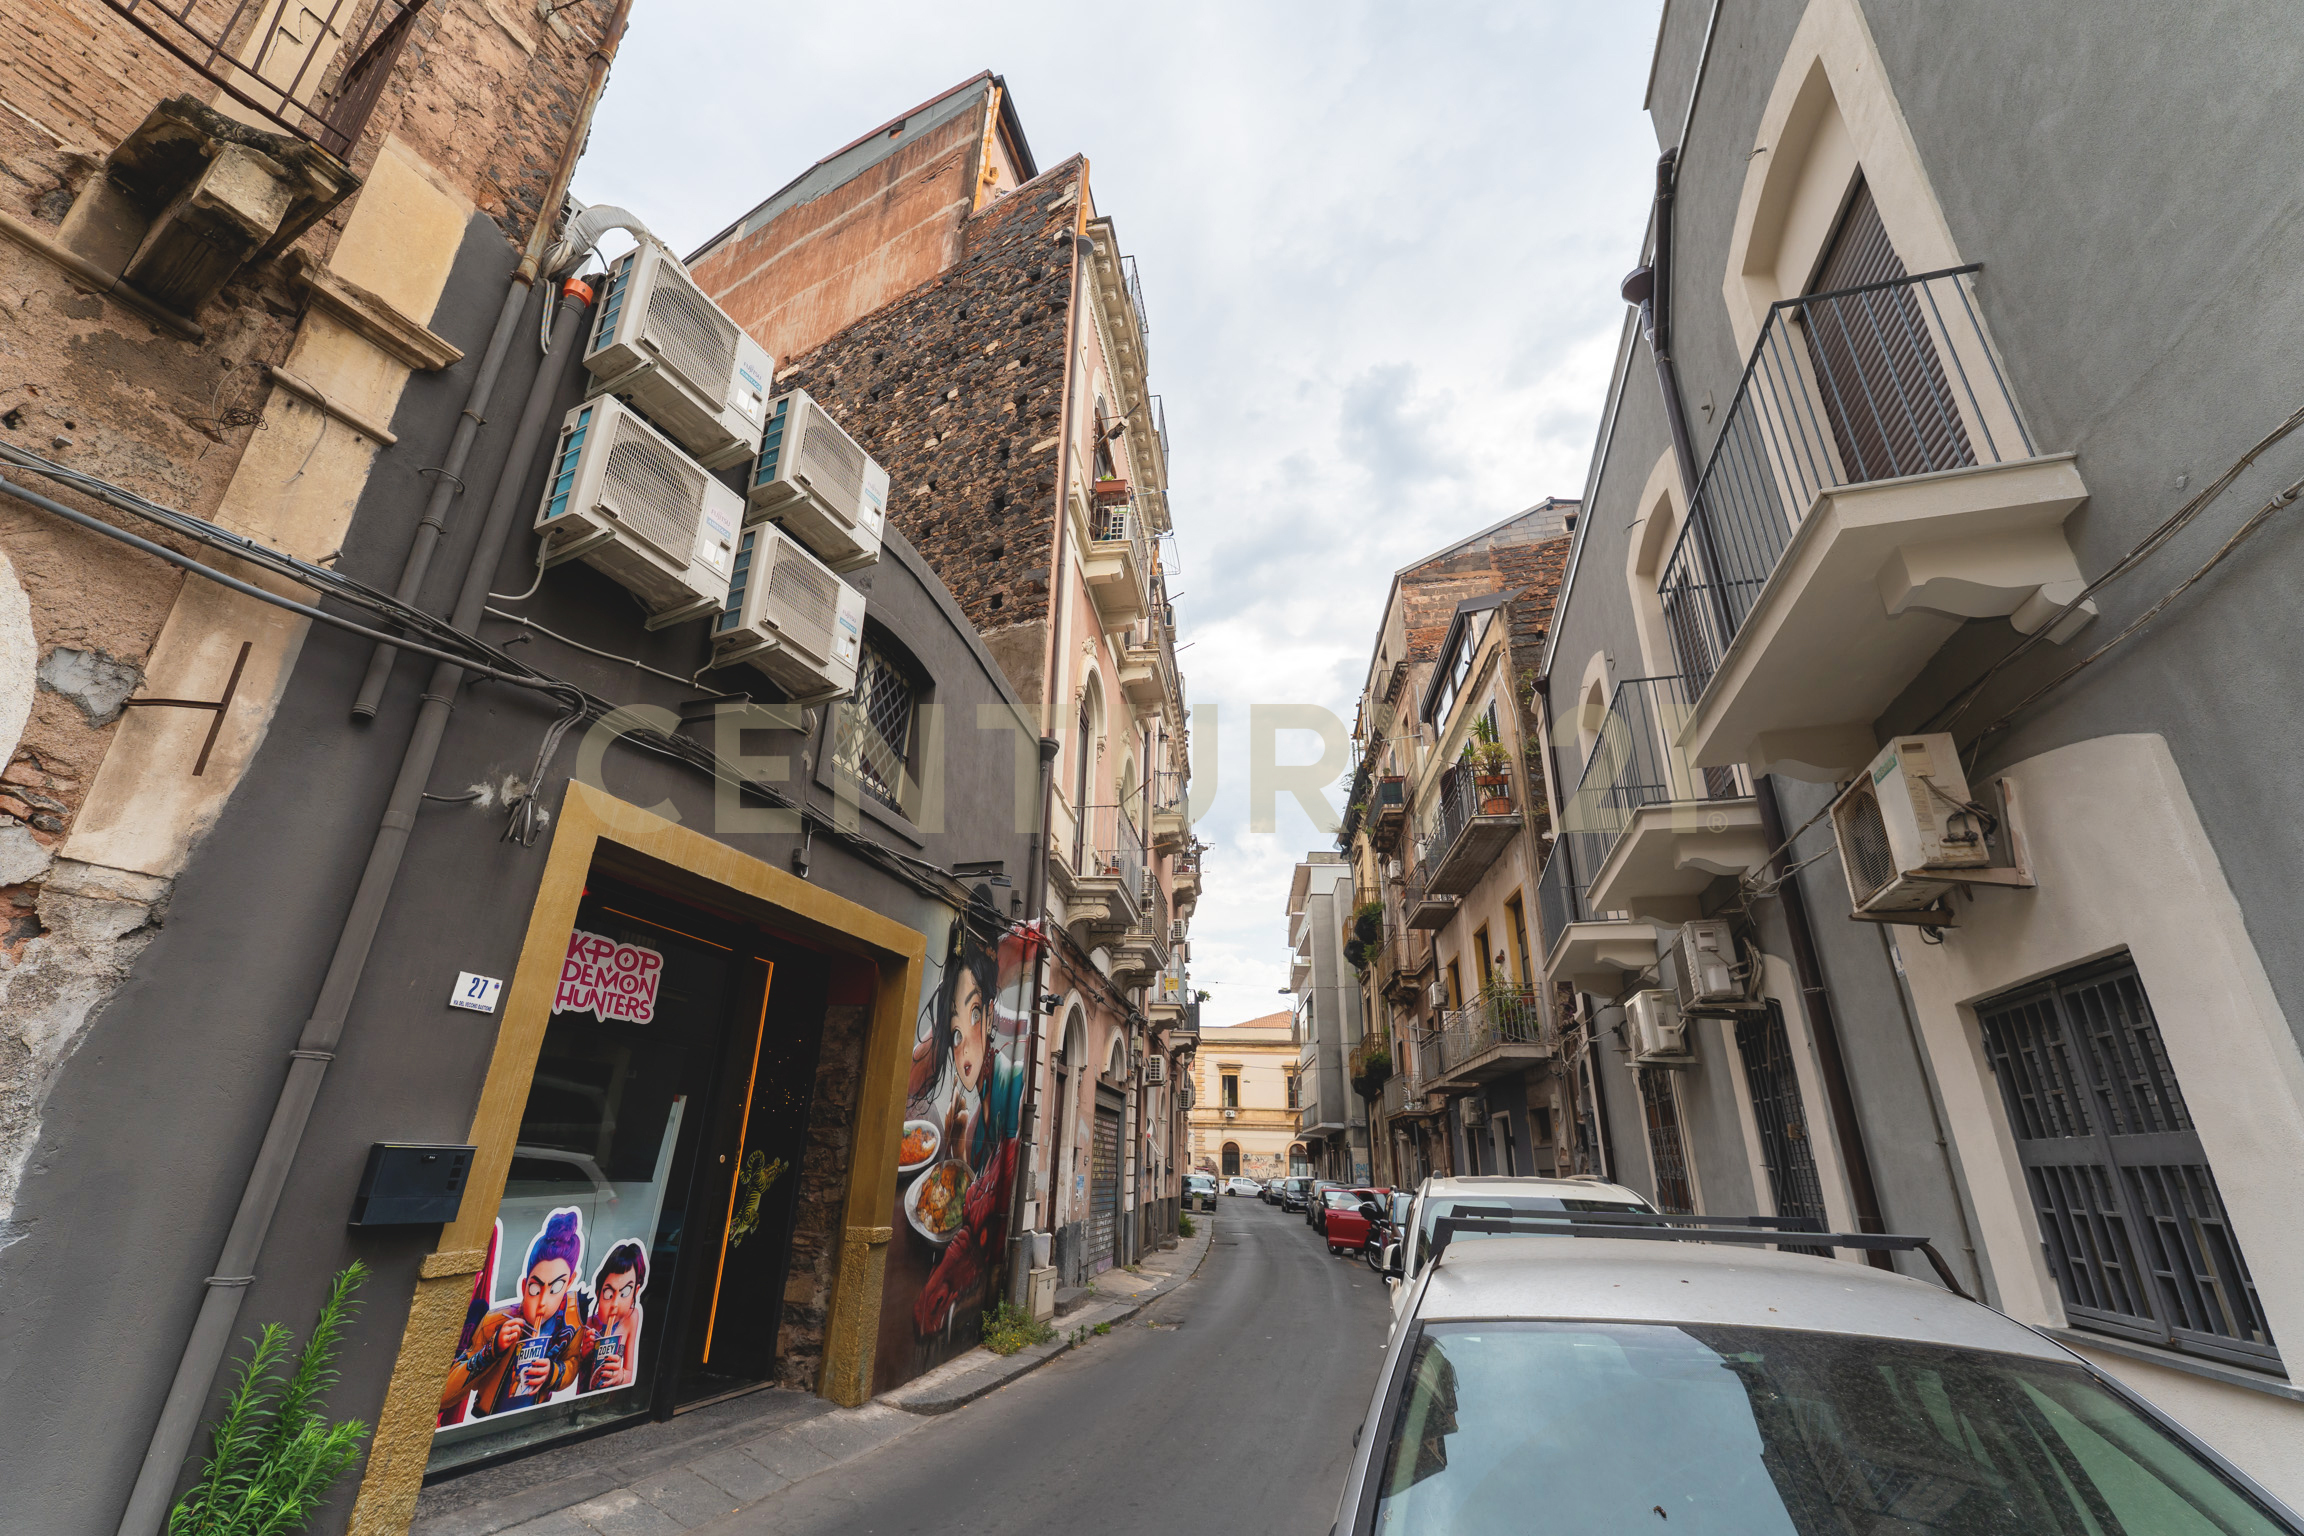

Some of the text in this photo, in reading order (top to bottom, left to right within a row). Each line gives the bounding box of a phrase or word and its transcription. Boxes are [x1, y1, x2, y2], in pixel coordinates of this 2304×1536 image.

[467, 977, 489, 999] 27
[560, 959, 657, 1004] DEMON
[555, 982, 651, 1020] HUNTERS
[519, 1346, 542, 1360] RUMI
[599, 1344, 615, 1356] ZOEY
